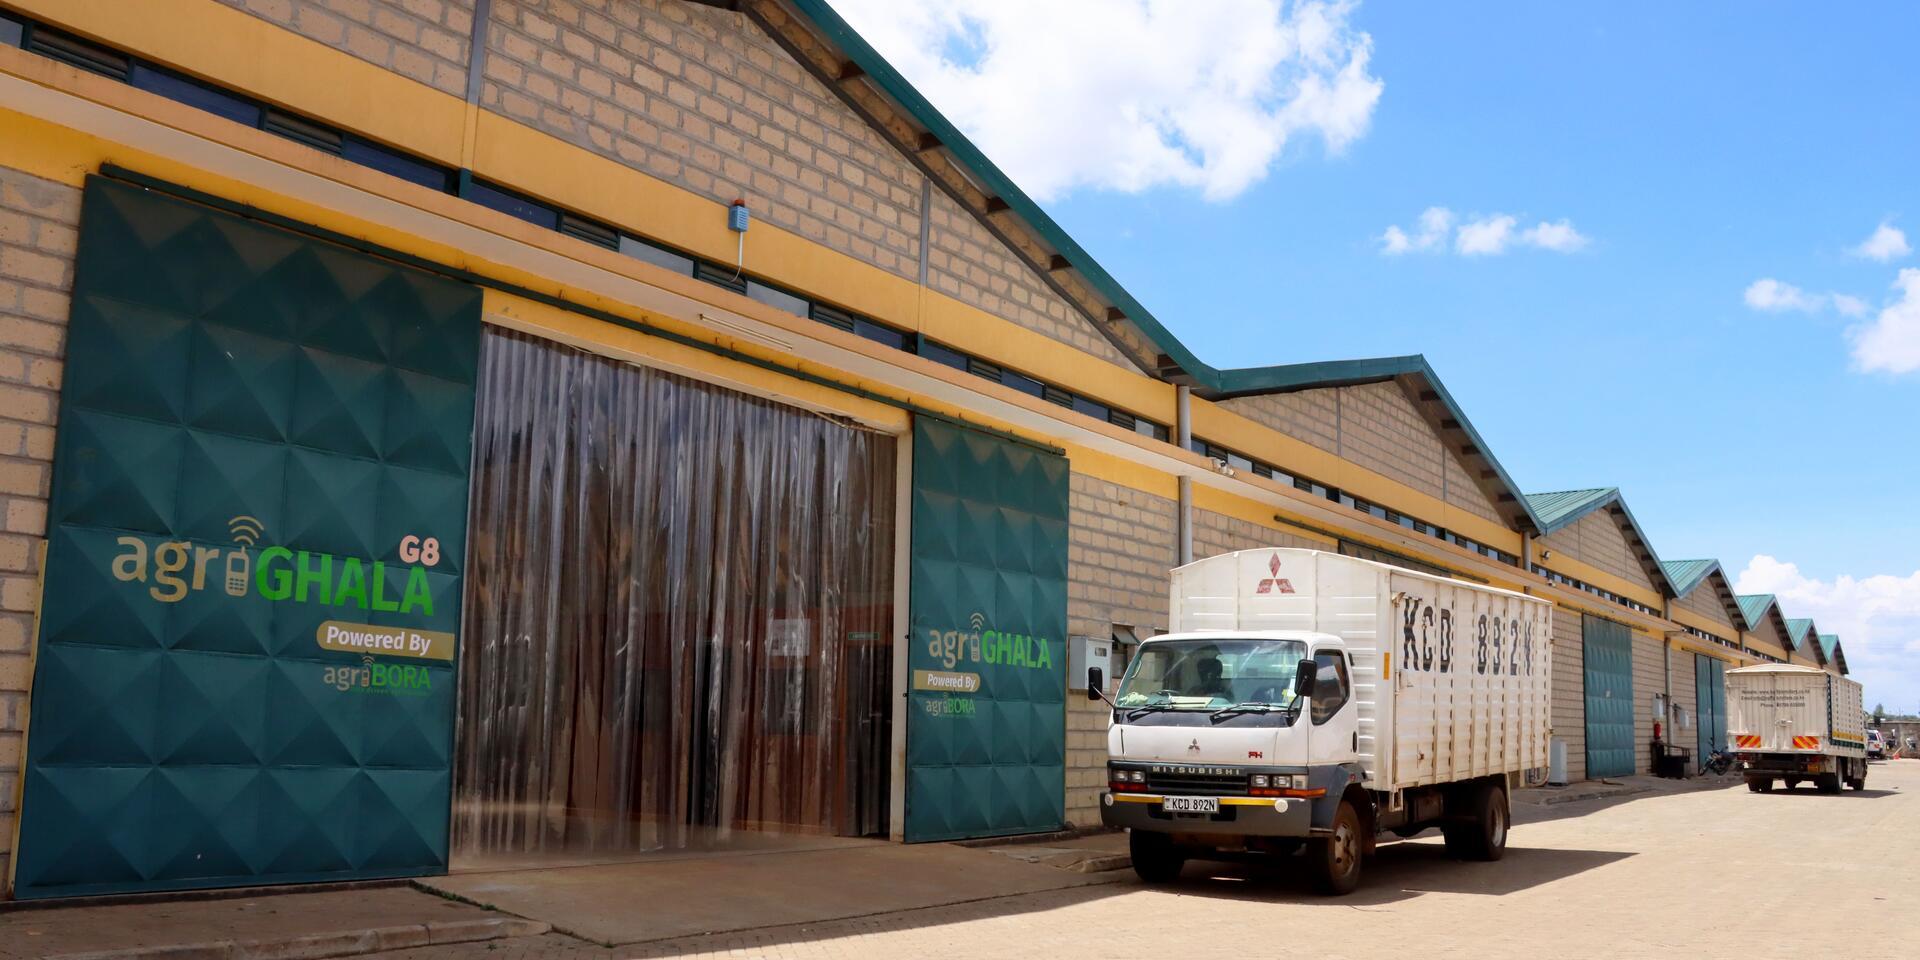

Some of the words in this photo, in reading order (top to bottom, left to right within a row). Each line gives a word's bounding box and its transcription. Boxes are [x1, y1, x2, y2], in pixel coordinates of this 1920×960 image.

[398, 534, 440, 568] G8
[326, 625, 405, 651] Powered
[409, 632, 431, 656] By
[1403, 596, 1452, 674] KCD
[1477, 614, 1532, 677] 892N
[927, 672, 963, 690] Powered
[965, 674, 976, 692] By
[1152, 766, 1240, 776] MITSUBISHI
[1171, 797, 1190, 810] KCD
[1192, 799, 1216, 811] 892N
